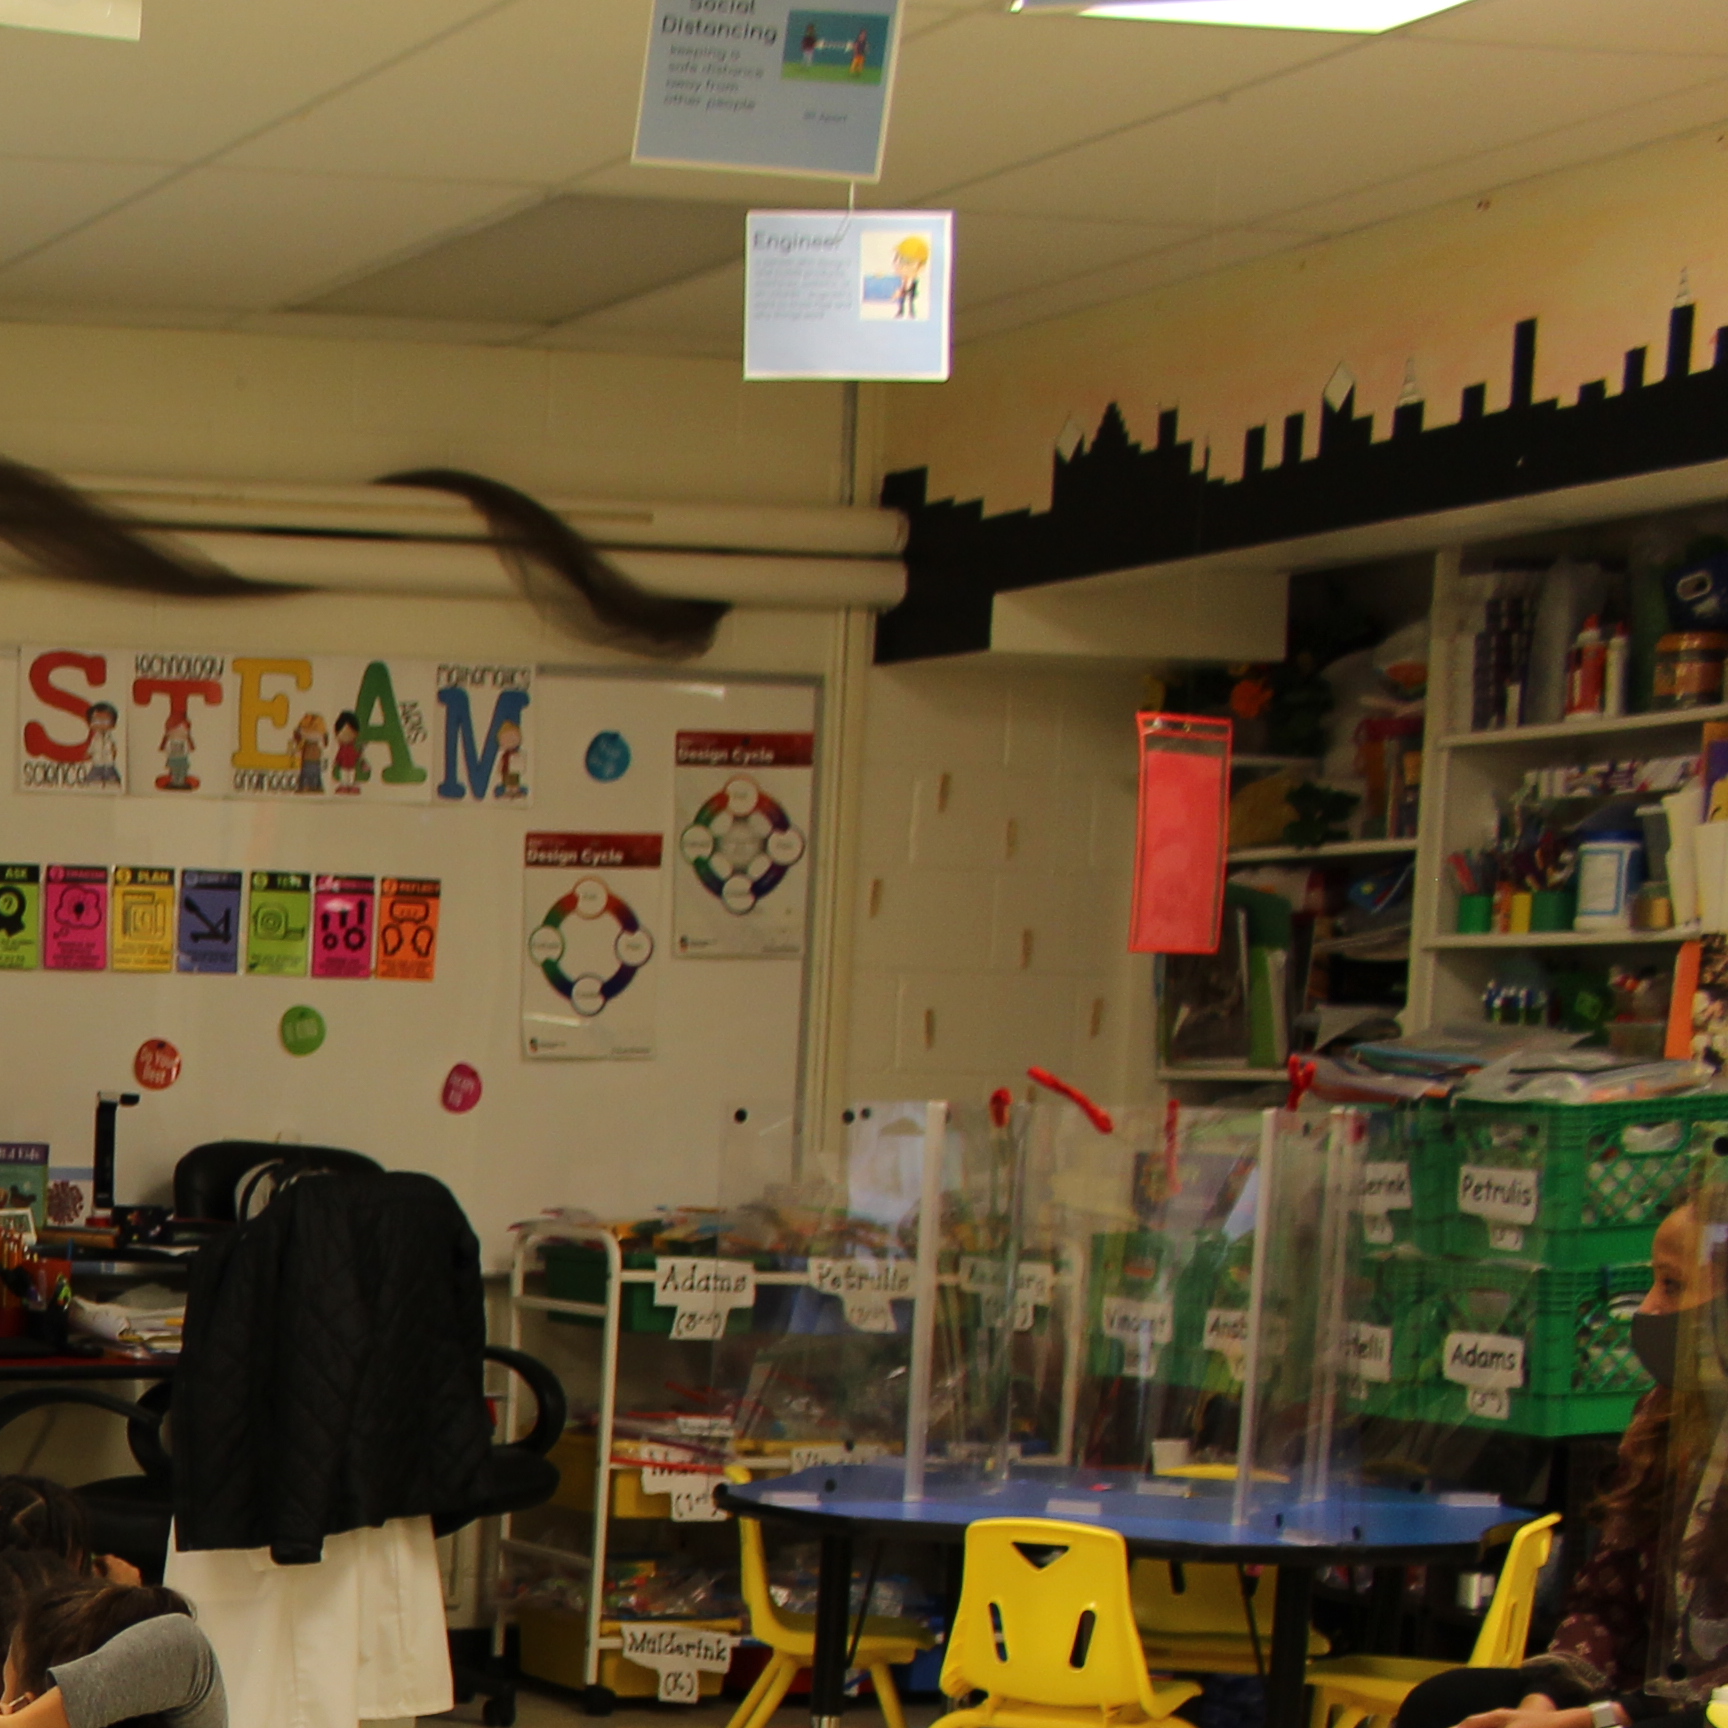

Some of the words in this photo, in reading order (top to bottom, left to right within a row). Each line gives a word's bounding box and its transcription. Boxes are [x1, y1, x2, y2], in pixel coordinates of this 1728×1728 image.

[661, 15, 778, 46] Distancing
[23, 651, 107, 764] S
[231, 657, 314, 770] E
[331, 660, 428, 785] A
[436, 687, 531, 801] M
[678, 746, 728, 766] Design
[731, 747, 775, 767] Cycle
[525, 848, 578, 867] Design
[580, 848, 625, 867] Cycle
[660, 1263, 748, 1294] Adams
[1449, 1342, 1517, 1372] Adams
[663, 1671, 696, 1698] (K)
